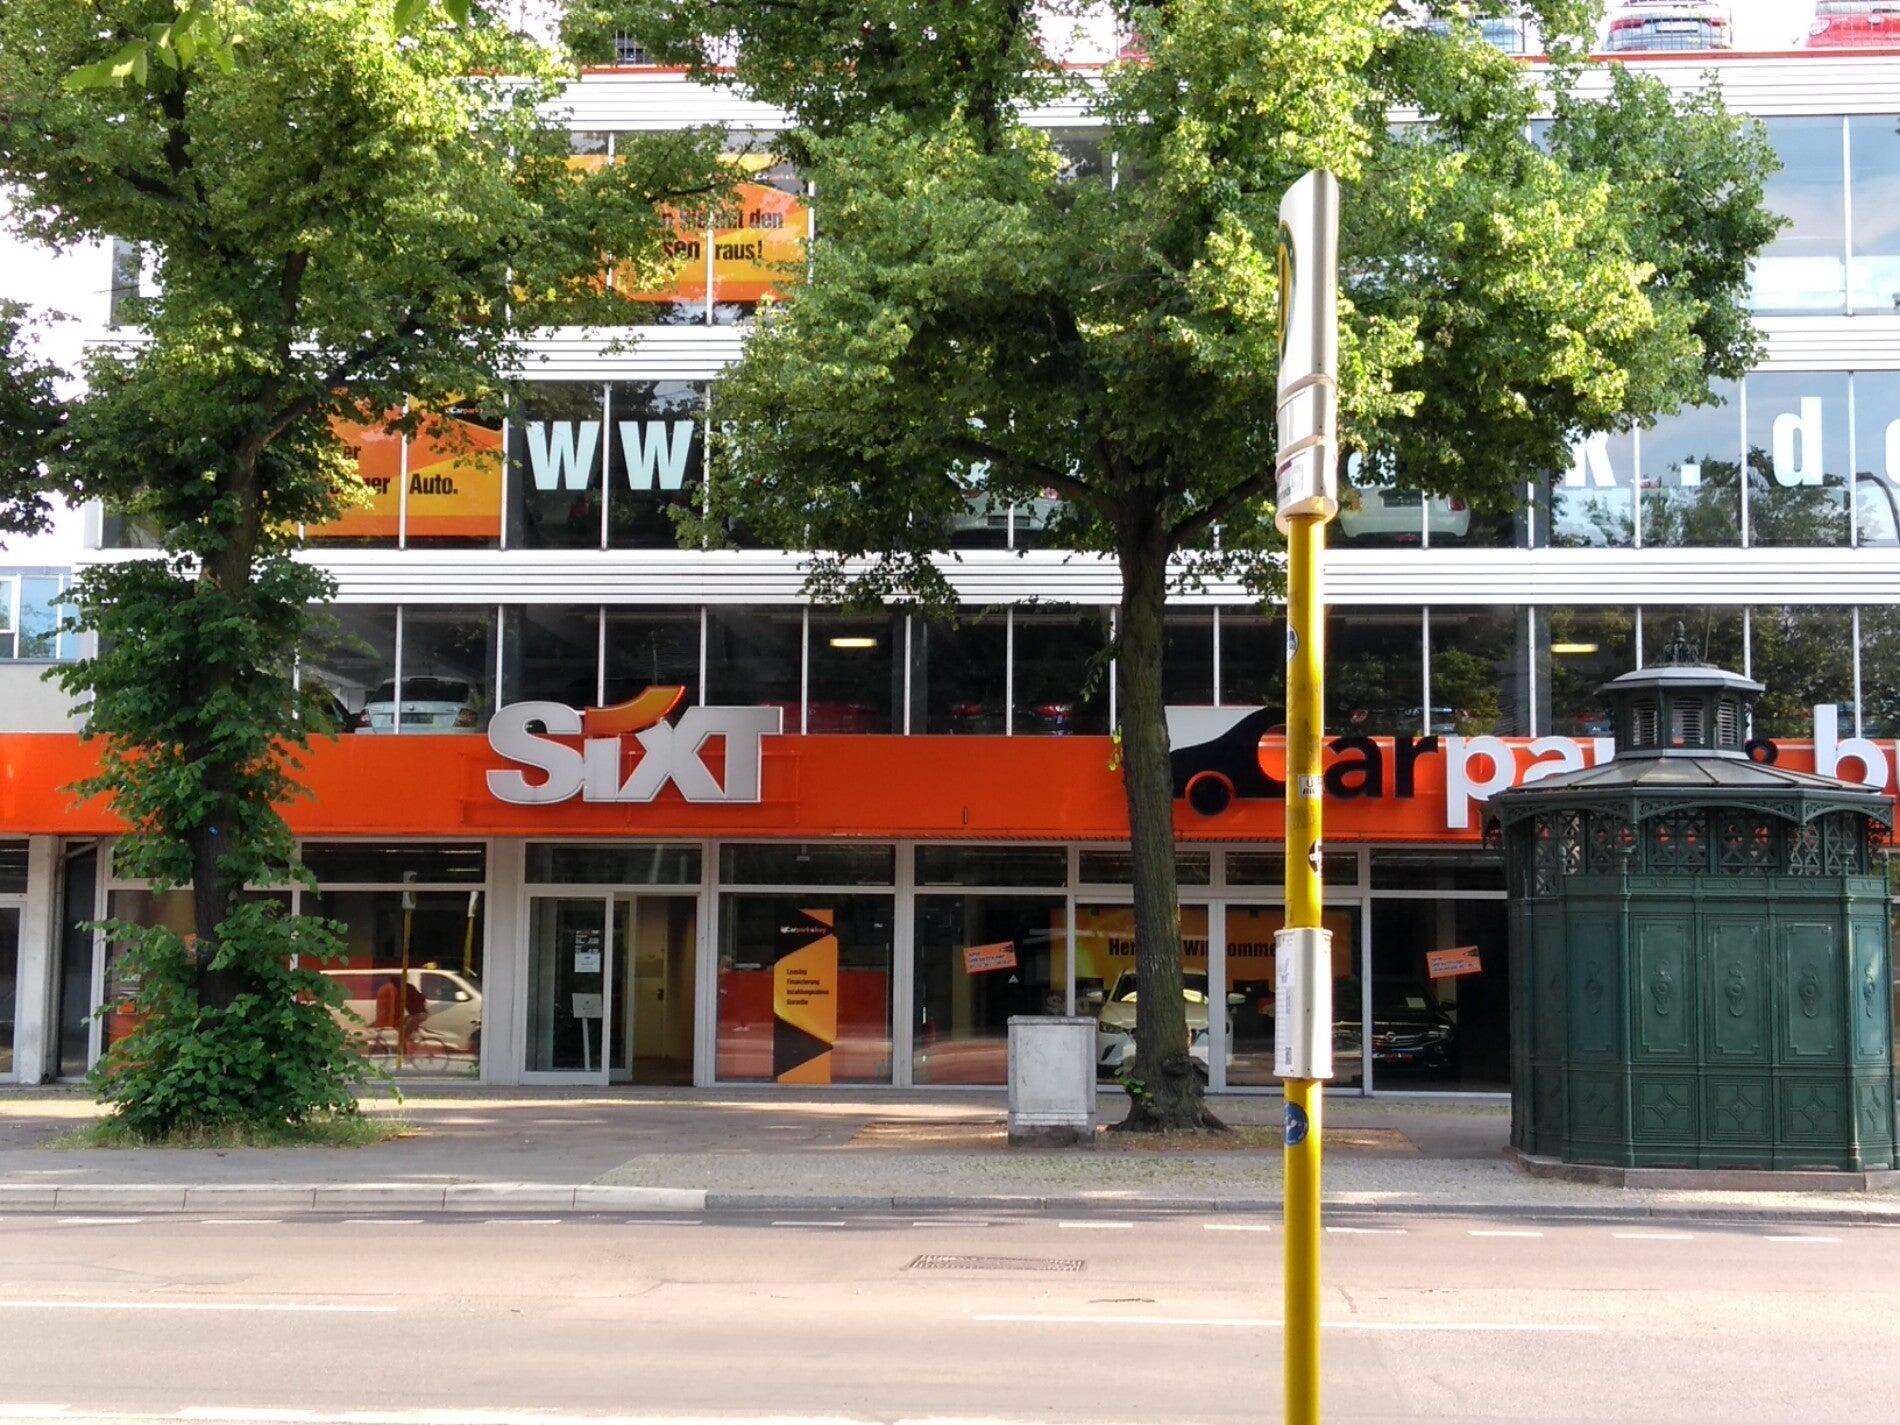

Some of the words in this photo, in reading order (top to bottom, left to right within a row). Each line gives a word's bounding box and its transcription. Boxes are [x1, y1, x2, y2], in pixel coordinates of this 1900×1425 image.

[749, 208, 783, 229] den
[715, 240, 762, 260] raus!
[409, 473, 458, 495] Auto.
